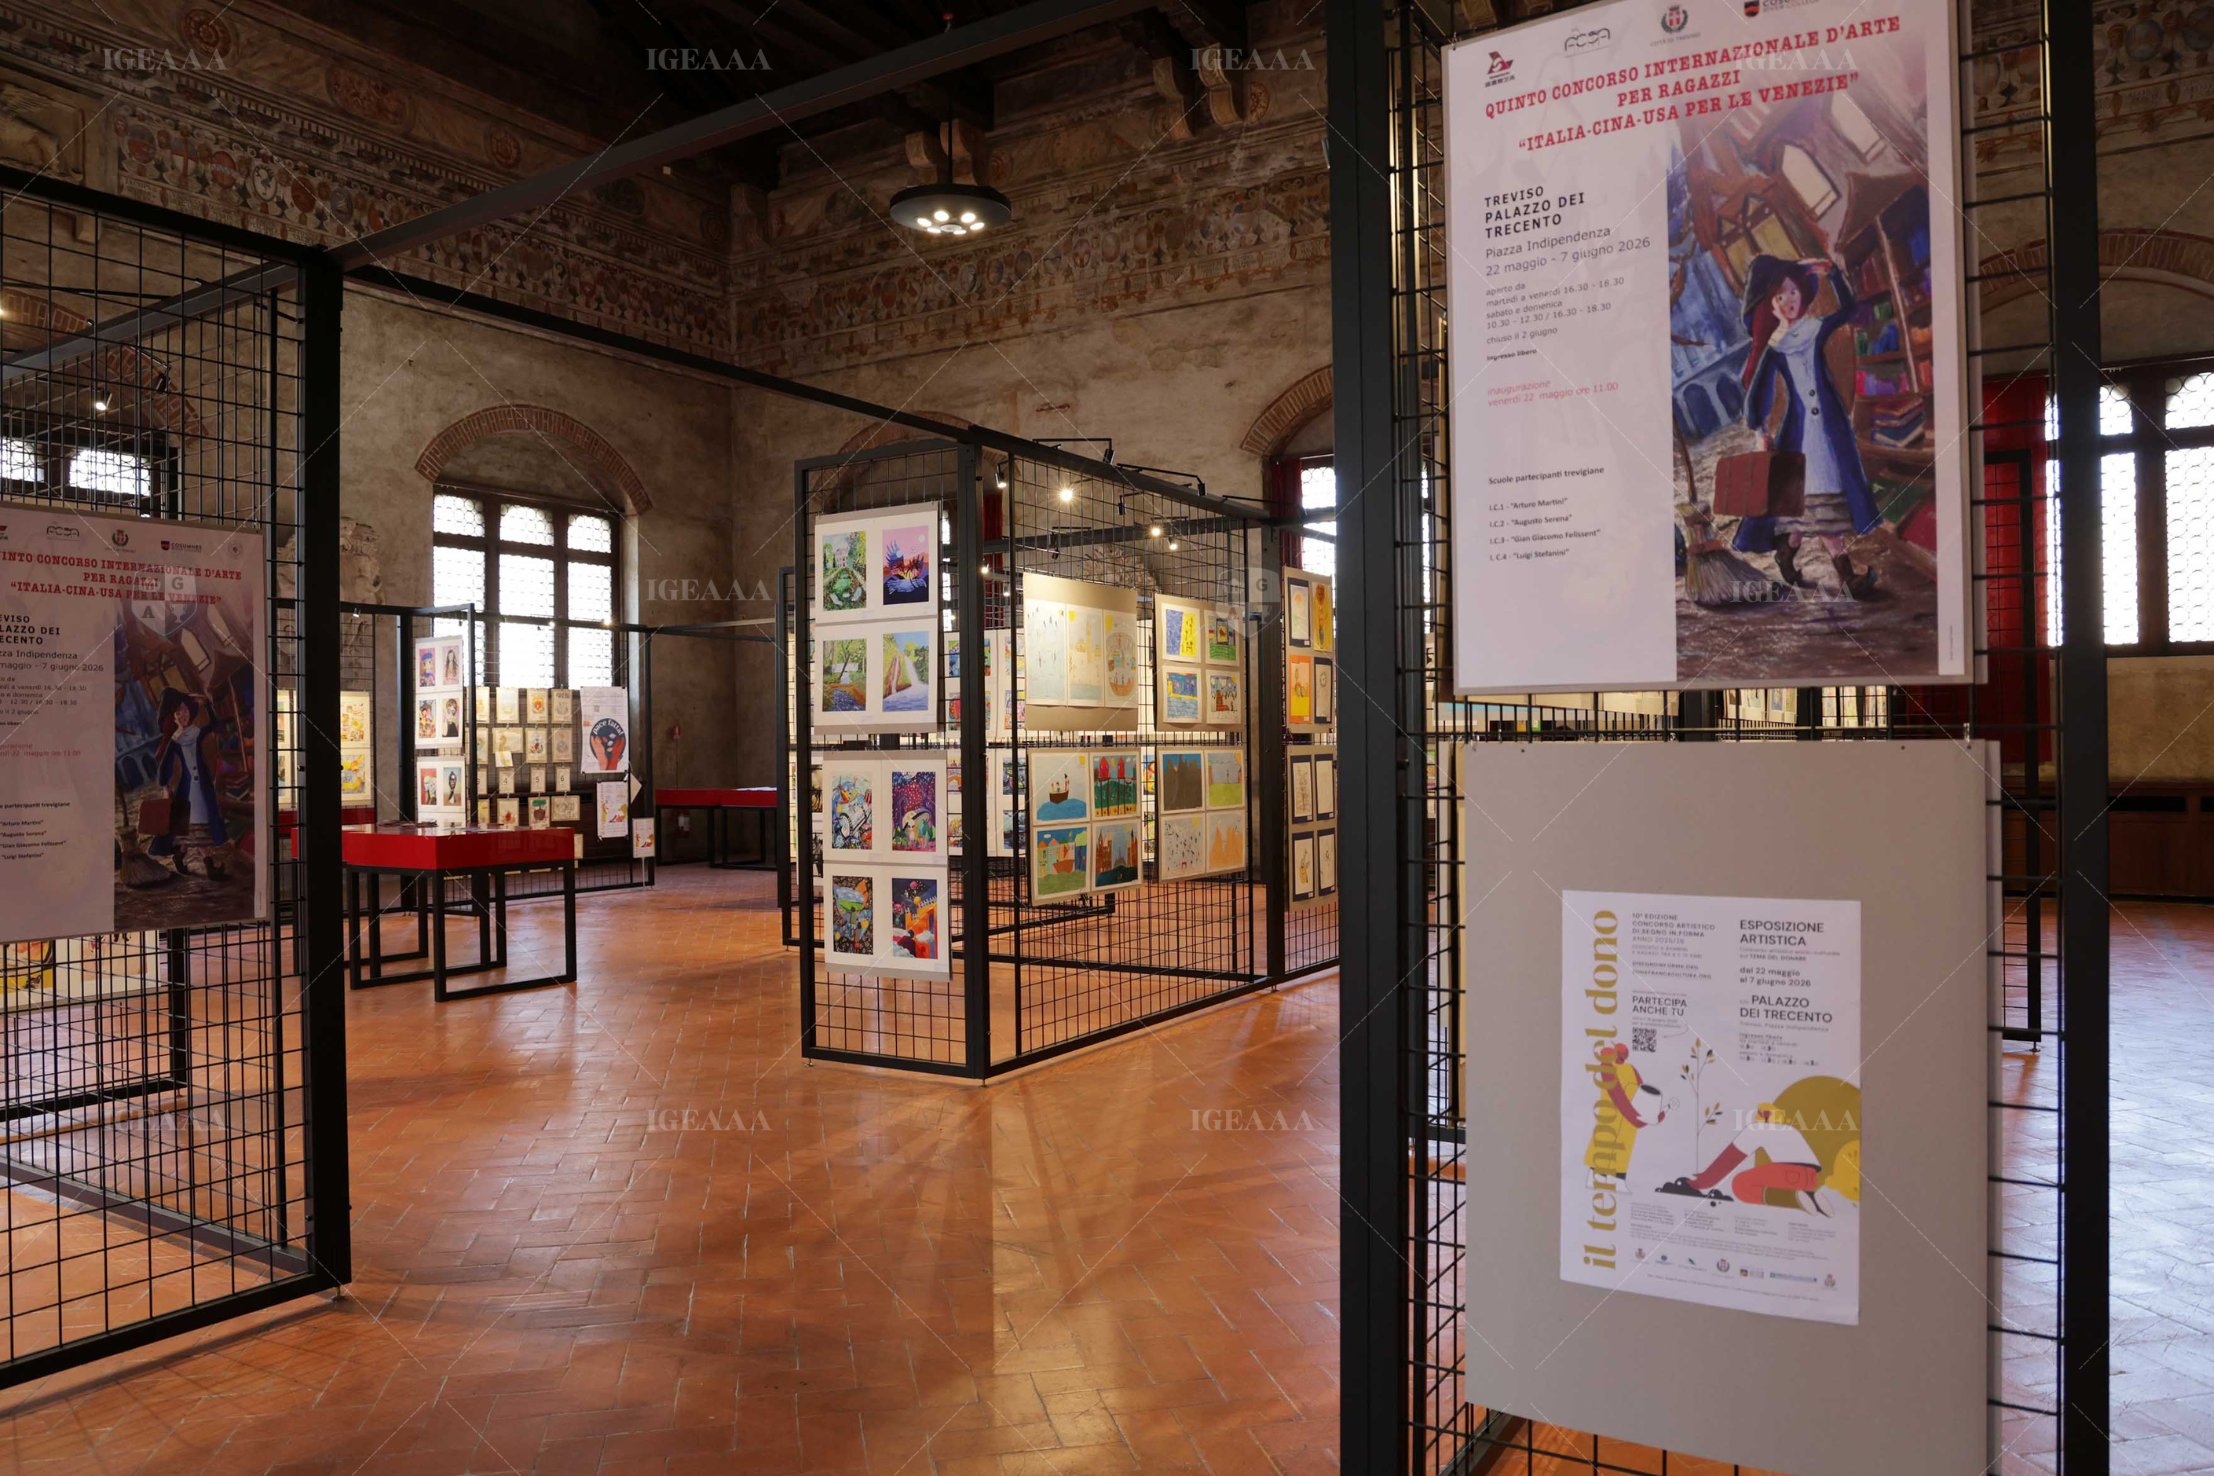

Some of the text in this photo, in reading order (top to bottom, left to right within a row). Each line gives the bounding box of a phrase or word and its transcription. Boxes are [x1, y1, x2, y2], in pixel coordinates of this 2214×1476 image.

[1485, 90, 1547, 119] QUINTO
[1552, 67, 1639, 100] CONCORSO
[1644, 31, 1819, 78] INTERNAZIONALE
[1826, 16, 1900, 43] D'ARTE
[1617, 70, 1740, 107] PER RAGAZZI
[1685, 96, 1722, 117] PER
[1729, 92, 1752, 109] LE
[1758, 72, 1859, 102] VENEZIE”
[1484, 186, 1544, 207] TREVISO
[1485, 192, 1585, 223] PALAZZO DEI
[1485, 213, 1562, 239] TRECENTO
[1486, 227, 1611, 259] Piazza Indipendenza
[1486, 237, 1651, 276] 22 maggio 7 giugno 2026
[1486, 282, 1526, 297] aperto da
[1564, 282, 1589, 294] 16.30
[1599, 277, 1625, 288] 18.30
[1486, 307, 1513, 319] sabato
[1523, 300, 1563, 314] domenica
[1487, 302, 1612, 329] 10.30 12.30 16.30 18.30
[1486, 333, 1512, 344] chiuso
[1522, 331, 1527, 339] 2
[1529, 326, 1558, 339] giugno
[1524, 392, 1534, 402] 22
[1539, 388, 1574, 401] maggio
[1576, 387, 1590, 396] ore
[1593, 381, 1619, 393] 11.00
[1488, 466, 1605, 485] Scuole partecipanti trevigiane
[1532, 532, 1564, 541] Giacomo
[0, 551, 242, 580] INTO CONCORSO INTERNAZIONALE D'ARTE
[83, 572, 158, 587] PER RAGAZZI
[126, 589, 149, 600] PER
[152, 591, 165, 601] LE
[41, 626, 61, 635] DEI
[16, 650, 78, 660] Indipendenza
[50, 662, 79, 672] giugno
[82, 664, 104, 672] 2026
[1740, 919, 1824, 933] ESPOSIZIONE
[1740, 934, 1806, 946] ARTISTICA
[1740, 966, 1753, 974] dal
[1768, 968, 1800, 978] maggio
[1756, 977, 1786, 987] giugno
[1789, 979, 1811, 987] 2026
[1632, 995, 1687, 1008] PARTECIPA
[1751, 994, 1810, 1009] PALAZZO
[1632, 1005, 1684, 1017] ANCHE TU
[1740, 1007, 1833, 1023] DEI TRECENTO
[1583, 910, 1626, 1271] il tempo del dono
